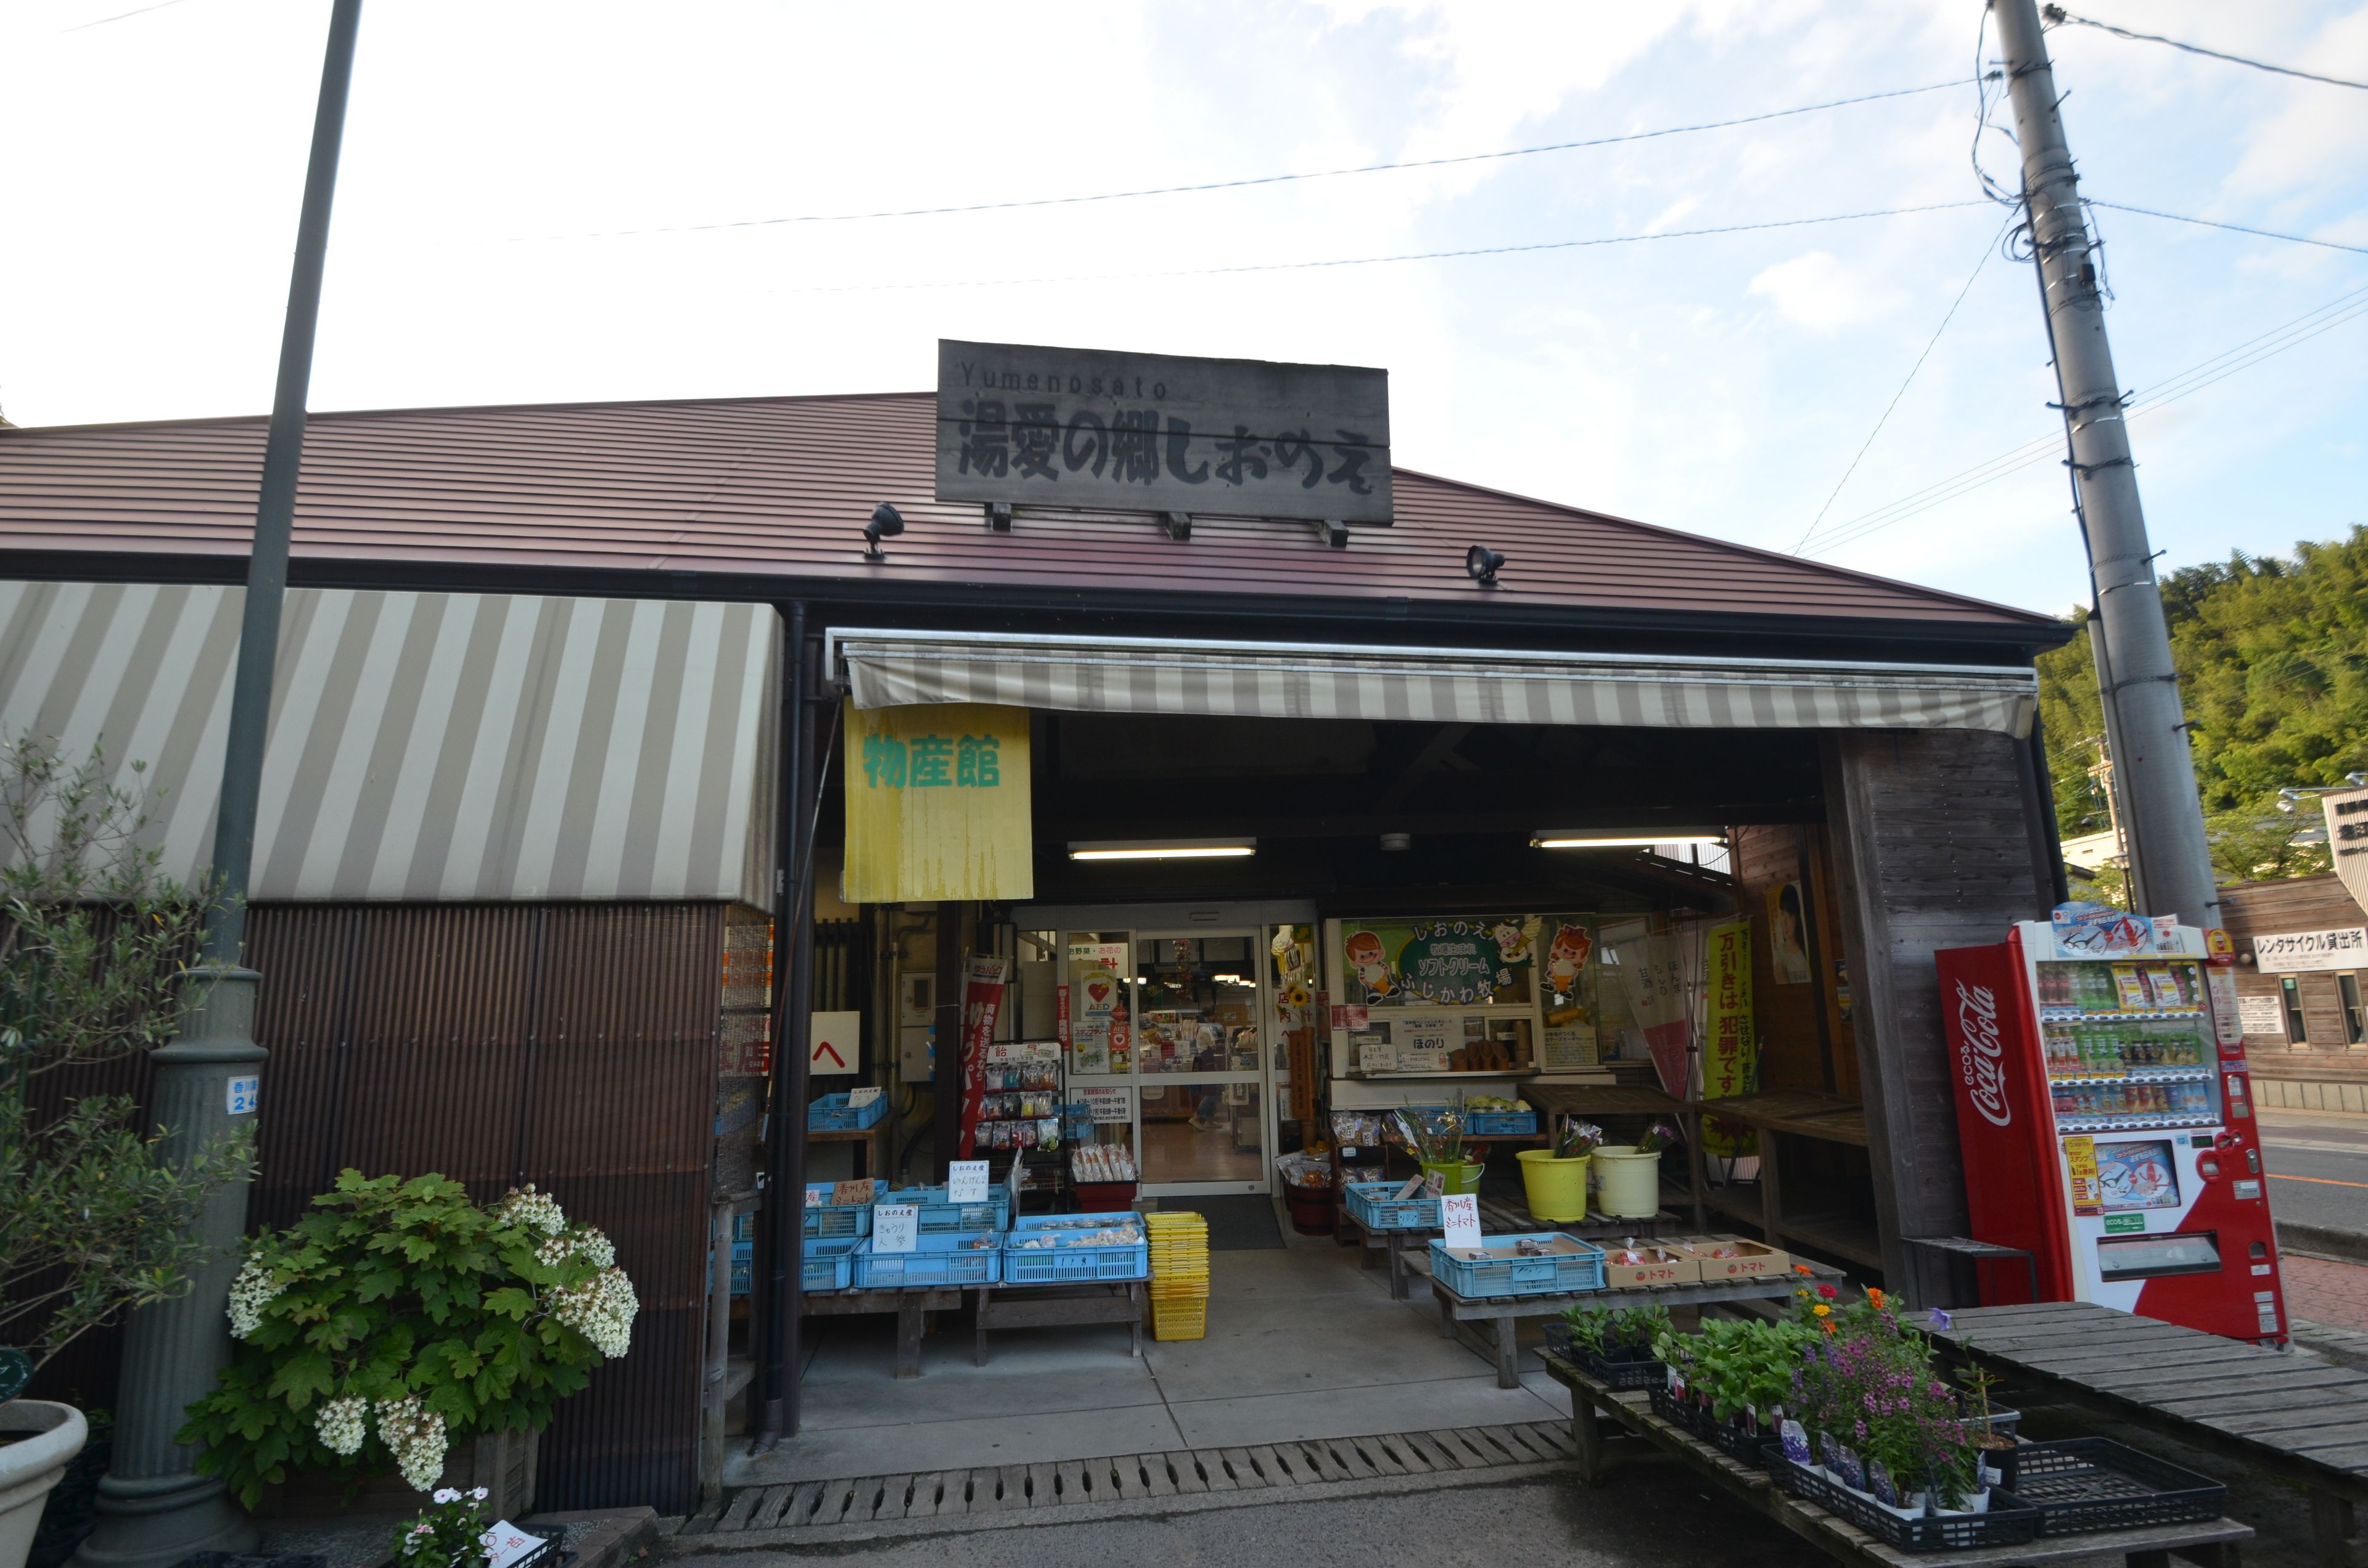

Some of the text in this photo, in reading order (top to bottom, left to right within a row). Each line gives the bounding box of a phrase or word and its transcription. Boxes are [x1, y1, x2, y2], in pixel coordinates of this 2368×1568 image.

[958, 361, 1167, 399] Yumenosato
[863, 732, 1000, 789] 物産館
[1413, 921, 1488, 942] しおのえ
[1429, 943, 1477, 956] 牧場生まれ
[2256, 930, 2363, 955] レンタサイクル貸出所
[1418, 957, 1490, 977] ソフトクリーム
[1717, 931, 1739, 1010] 万引きは
[1400, 967, 1513, 1004] ふじかわ牧場
[976, 1003, 996, 1082] 荷物を送るなら
[1413, 1038, 1445, 1049] ほのり
[995, 1046, 1006, 1057] 飴
[1954, 977, 2012, 1127] Coca-Cola
[2070, 1155, 2089, 1163] スタンプ
[953, 1164, 985, 1172] しおのえ産
[837, 1181, 871, 1196] 香川産
[1444, 1196, 1474, 1212] 香川産
[878, 1209, 913, 1217] しおのえ産
[878, 1223, 905, 1234] きゅうり
[1649, 1268, 1675, 1281] トマト
[1740, 1261, 1766, 1273] トマト
